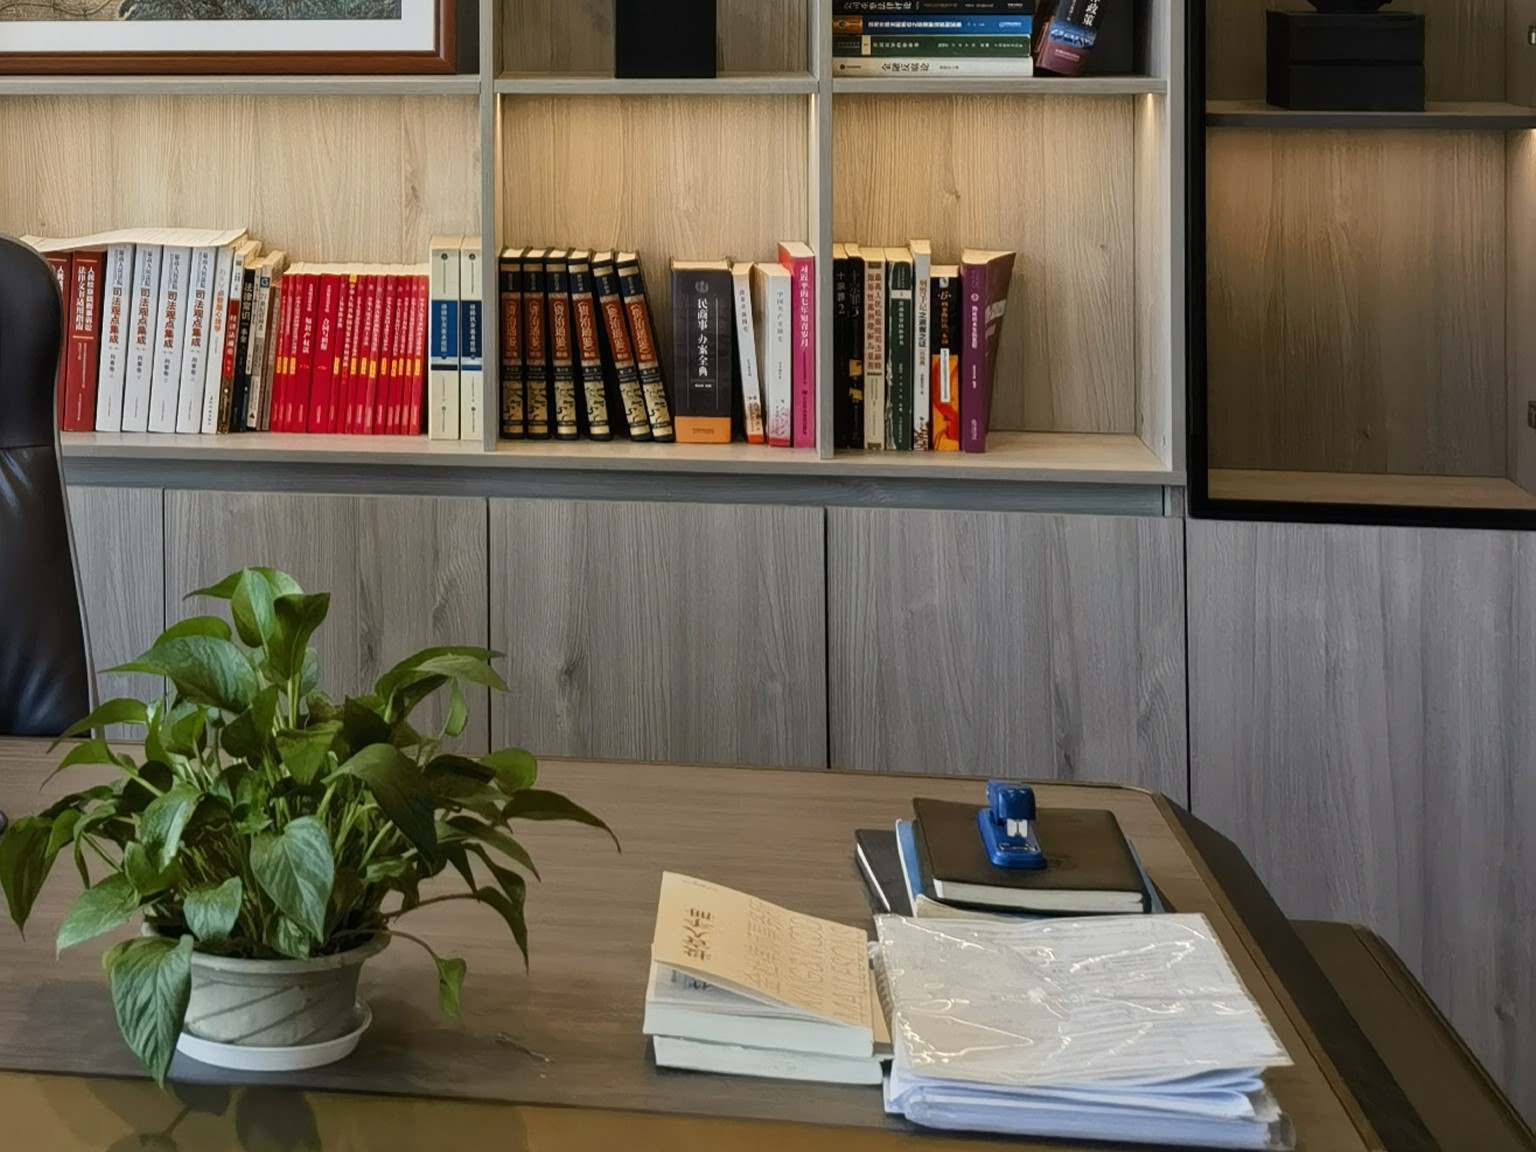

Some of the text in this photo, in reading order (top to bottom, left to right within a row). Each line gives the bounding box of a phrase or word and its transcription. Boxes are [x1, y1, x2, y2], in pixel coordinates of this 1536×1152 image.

[109, 287, 122, 345] 司法观点集成
[136, 288, 151, 346] 司法观点集成
[164, 290, 178, 349] 司法观点集成
[191, 289, 205, 347] 司法观点集成
